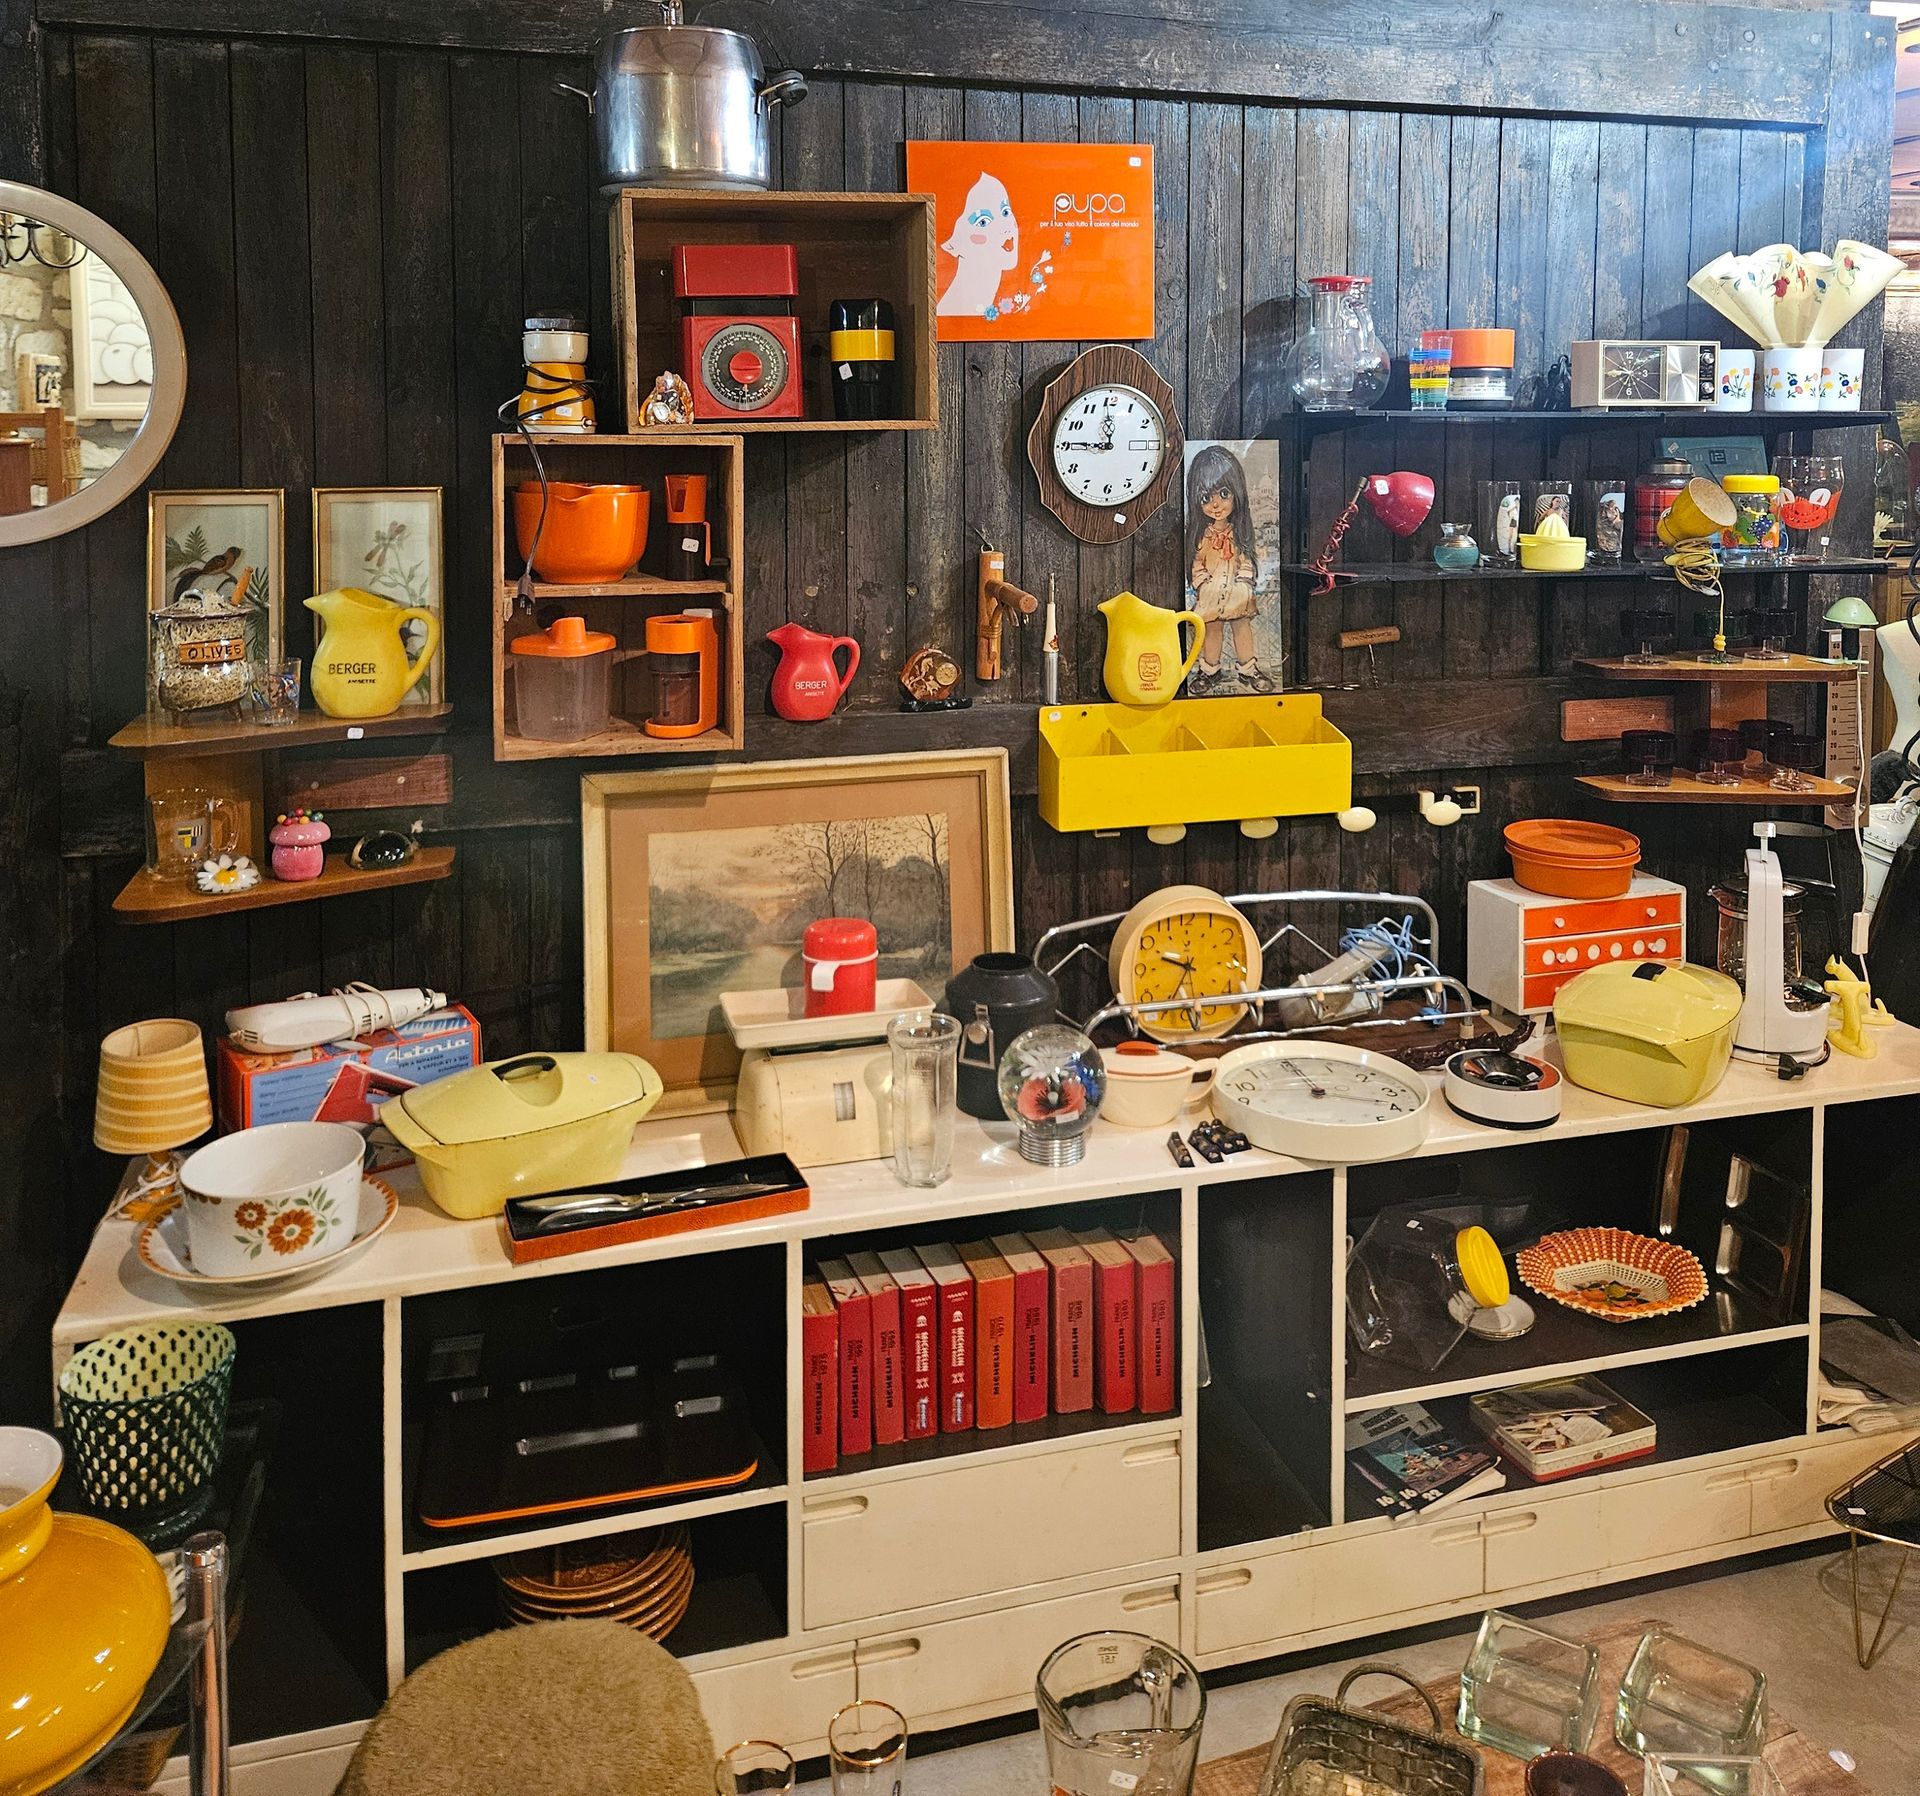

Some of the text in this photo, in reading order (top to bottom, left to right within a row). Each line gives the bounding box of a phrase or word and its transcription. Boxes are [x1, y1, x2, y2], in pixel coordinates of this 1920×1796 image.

[1054, 192, 1126, 221] pupa
[1039, 220, 1049, 228] per
[1625, 351, 1634, 359] 12
[1642, 369, 1648, 377] 3
[1626, 388, 1632, 396] 6
[1103, 396, 1118, 407] 12
[1083, 404, 1097, 414] 11
[1128, 403, 1134, 413] 1
[1068, 420, 1084, 431] 10
[1140, 418, 1150, 429] 2
[1060, 441, 1071, 451] 9
[1068, 463, 1078, 474] 8
[1083, 479, 1091, 490] 7
[1103, 484, 1112, 494] 6
[187, 644, 242, 660] OLIVES
[328, 662, 377, 675] BERGER
[795, 680, 828, 690] BERGER
[1221, 928, 1234, 945] 2
[384, 1039, 470, 1064] Astoria
[1355, 1073, 1369, 1083] 2
[1235, 1082, 1256, 1092] 10
[1381, 1087, 1398, 1097] 3
[1389, 1102, 1402, 1112] 4
[920, 1331, 929, 1372] MICHELIN
[956, 1326, 965, 1366] MICHELIN
[1028, 1334, 1036, 1384] MICHELIN
[885, 1356, 894, 1409] MICHELIN
[851, 1365, 859, 1419] MICHELIN
[815, 1382, 823, 1435] MICHELIN
[1398, 1488, 1419, 1500] 16
[1375, 1495, 1396, 1507] 16
